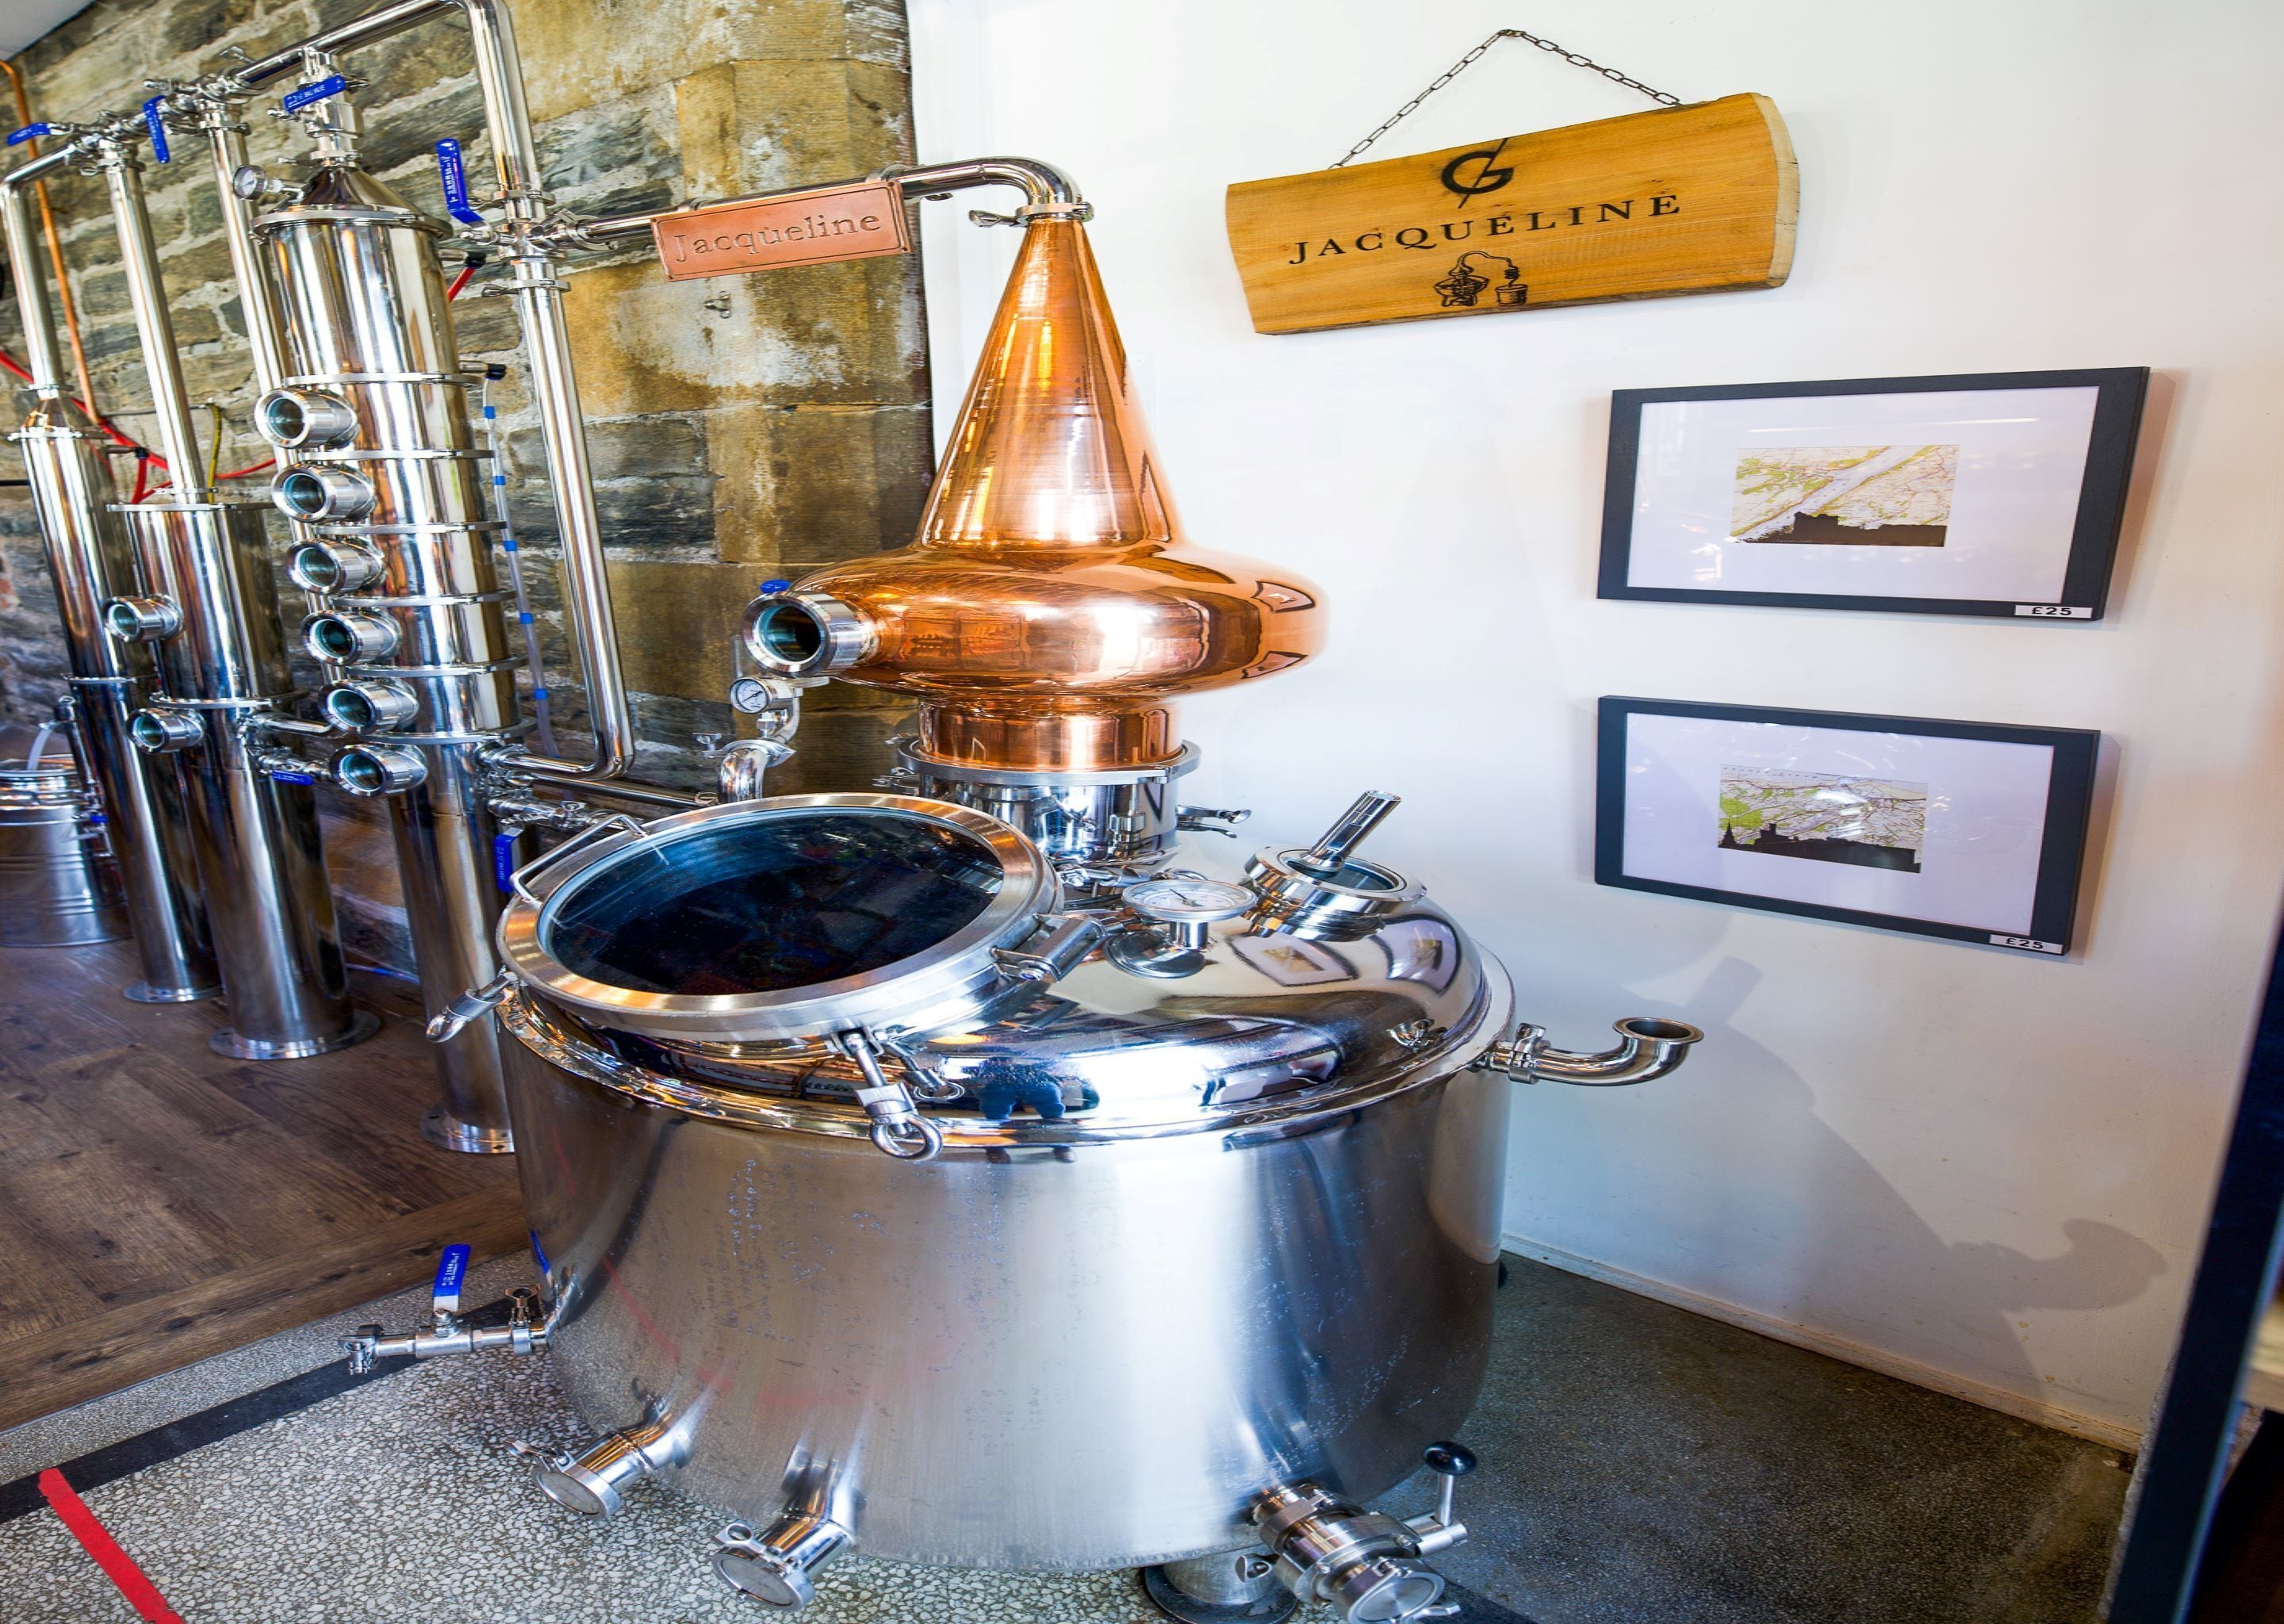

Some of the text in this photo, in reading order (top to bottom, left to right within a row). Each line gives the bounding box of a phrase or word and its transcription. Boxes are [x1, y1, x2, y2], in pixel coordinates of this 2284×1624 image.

[673, 215, 880, 262] Jacqueline
[1289, 194, 1680, 265] JACQUELINE
[2032, 607, 2071, 616] £25
[2006, 938, 2044, 949] £25
